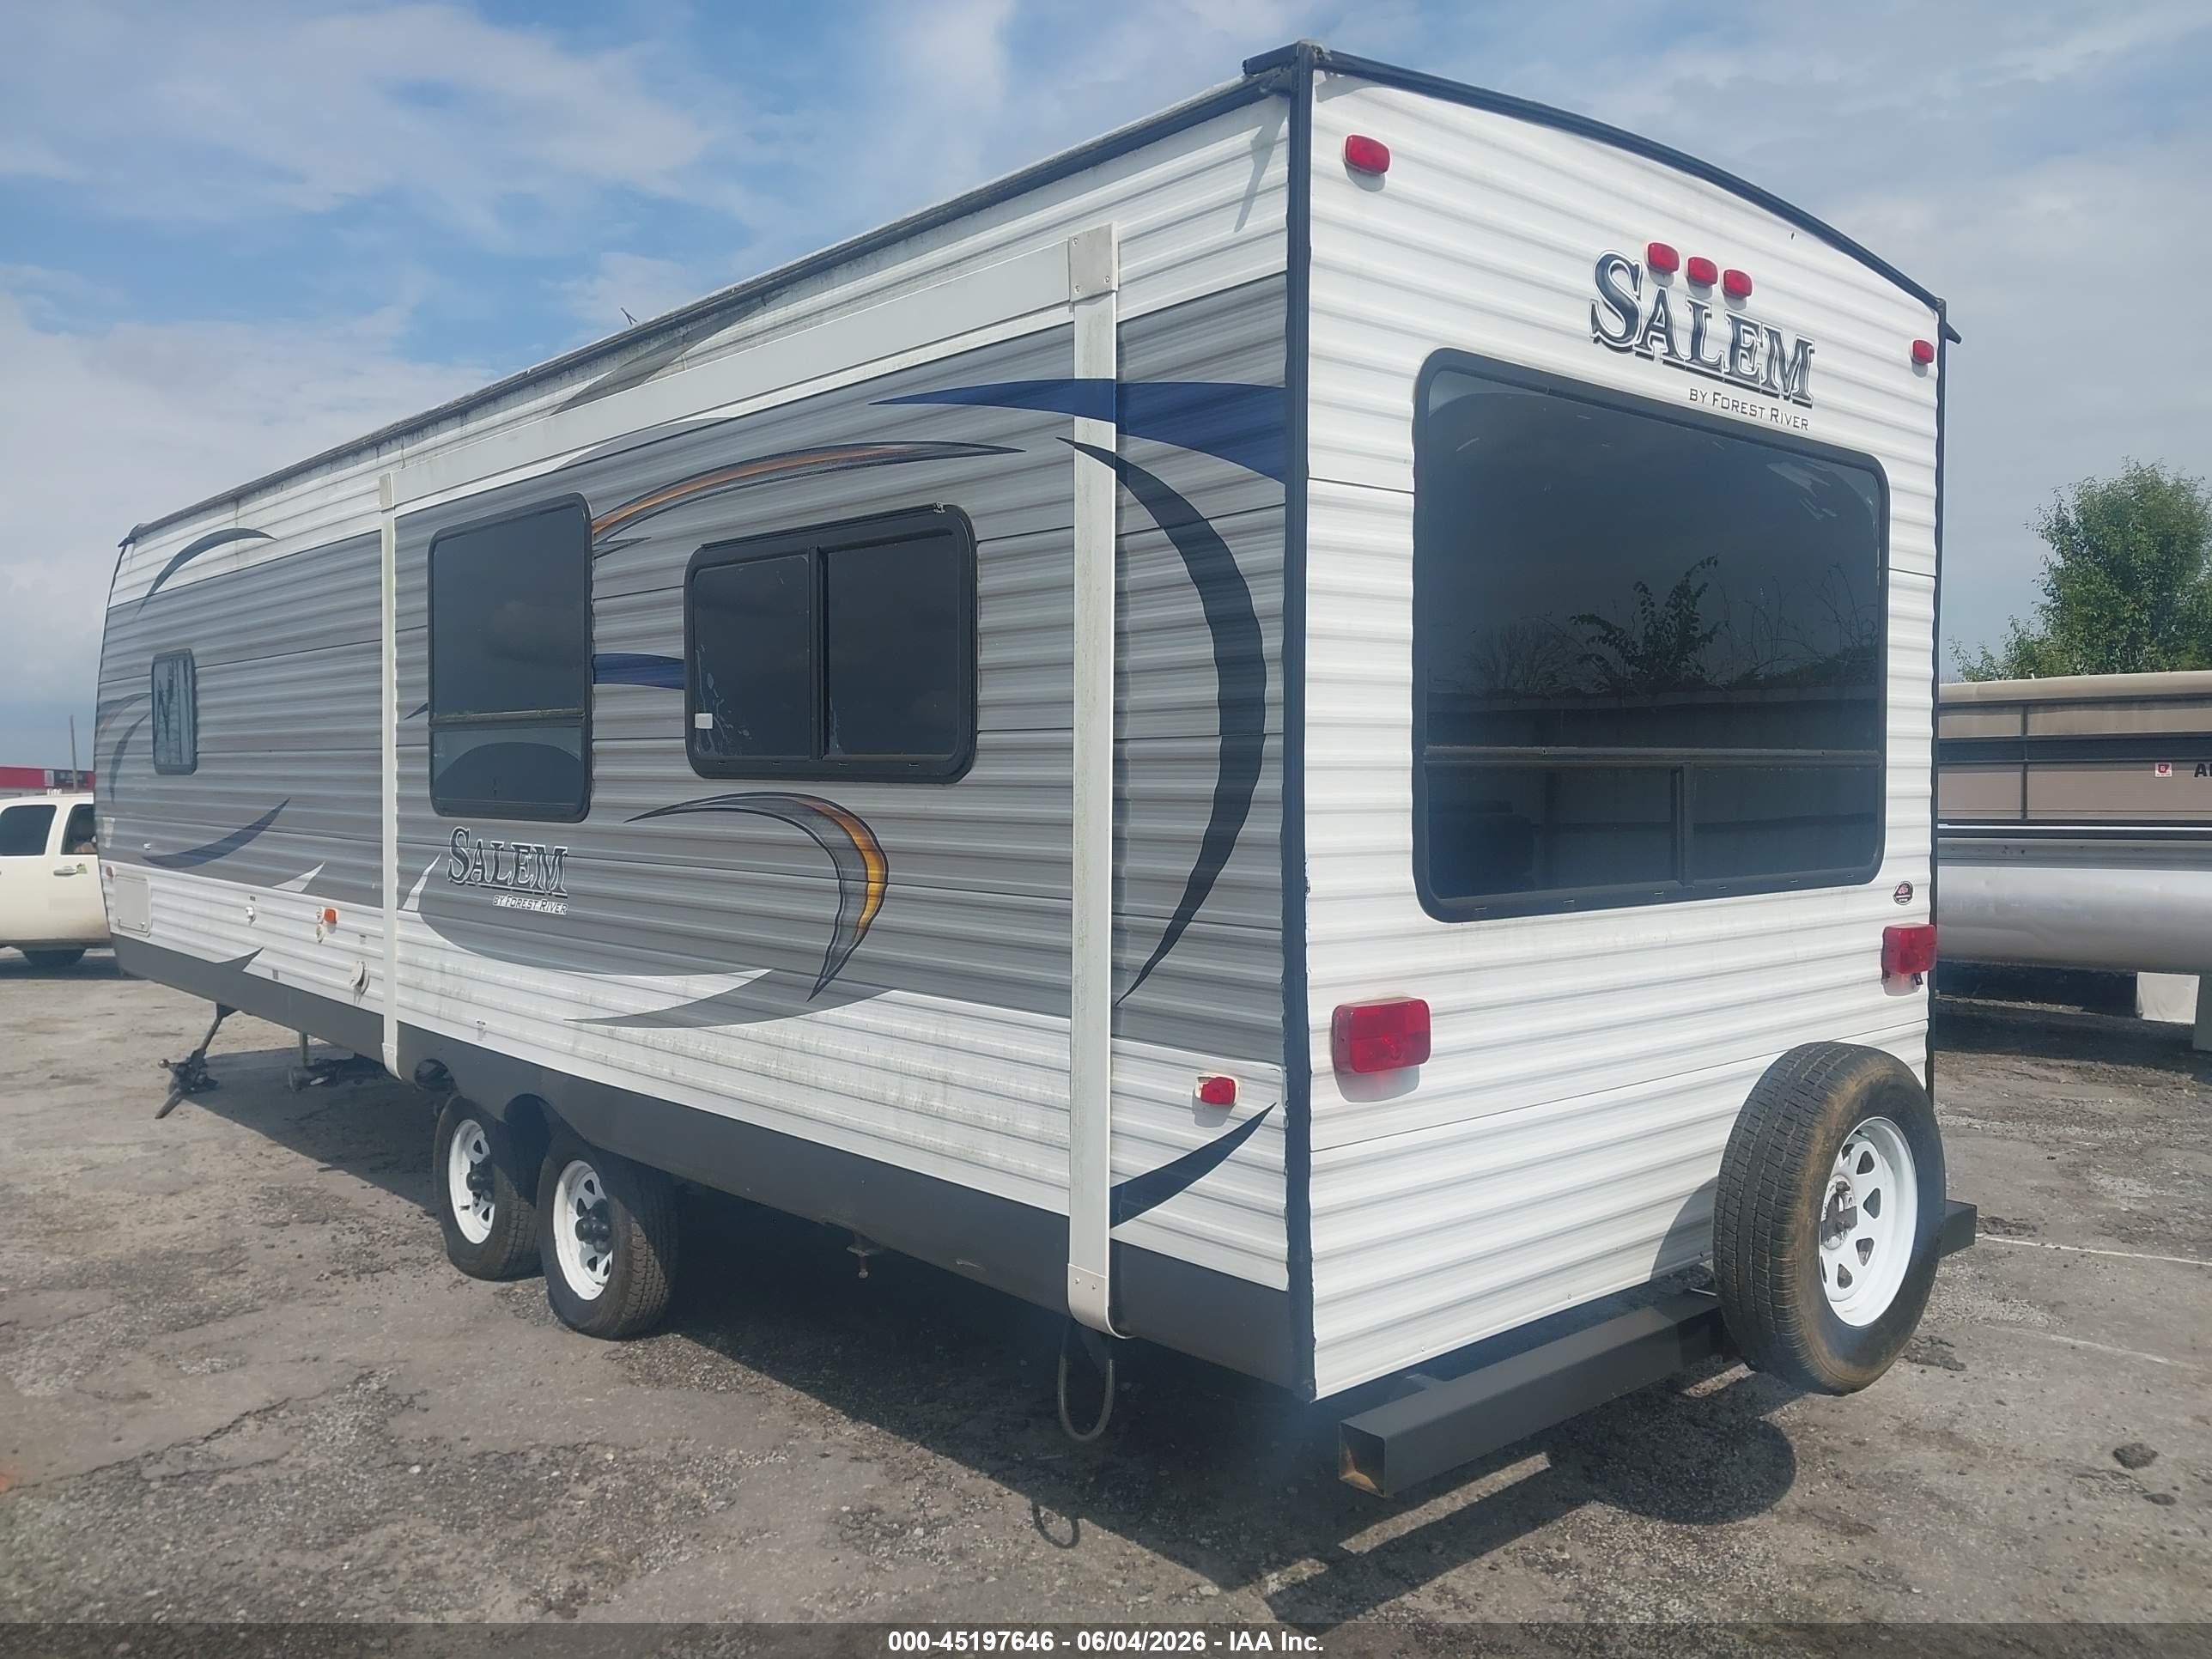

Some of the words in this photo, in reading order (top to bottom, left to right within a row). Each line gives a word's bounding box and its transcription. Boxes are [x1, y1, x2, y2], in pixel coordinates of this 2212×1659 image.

[1590, 249, 1814, 409] SALEM
[1689, 387, 1708, 406] BY
[1712, 392, 1765, 418] FOREST
[1770, 408, 1808, 430] RIVER
[447, 827, 568, 898] SALEM
[507, 896, 538, 909] FOREST
[541, 899, 568, 915] RIVER
